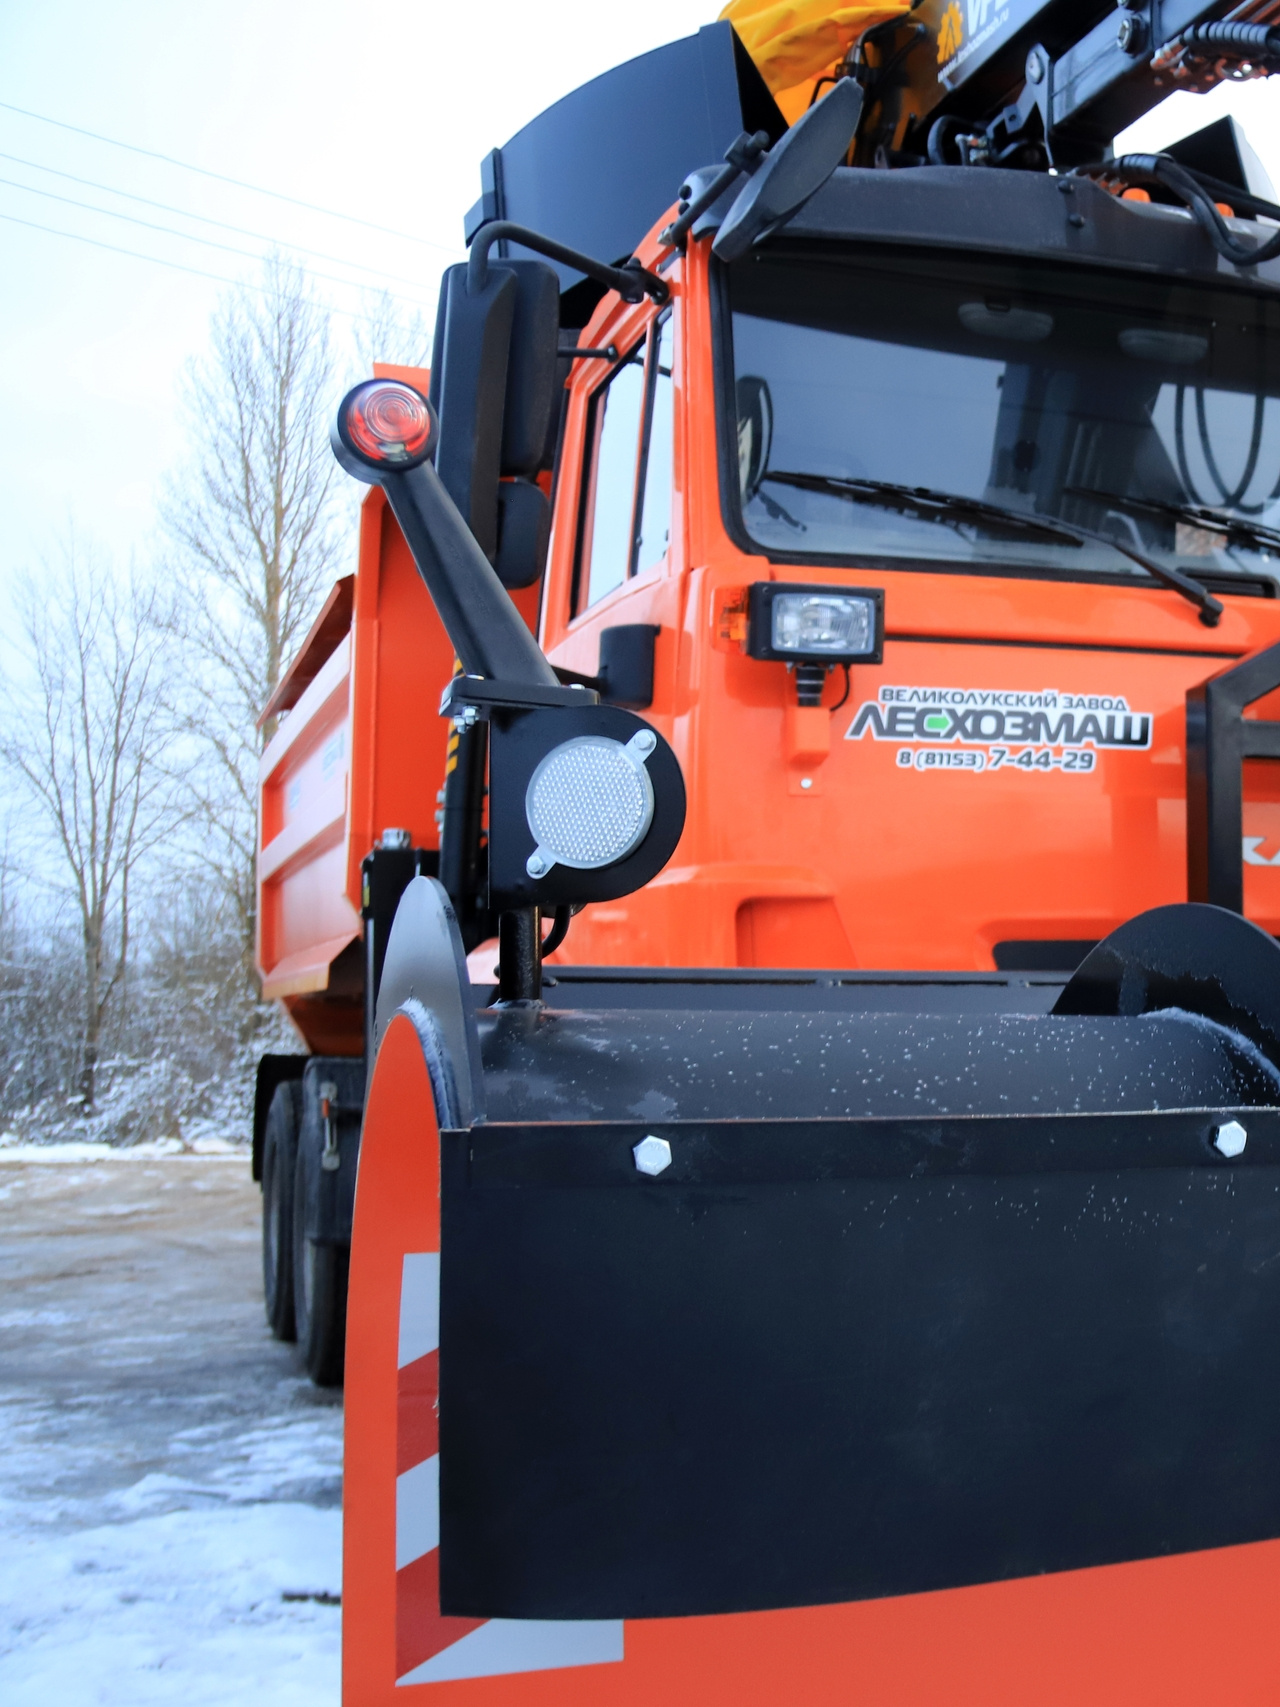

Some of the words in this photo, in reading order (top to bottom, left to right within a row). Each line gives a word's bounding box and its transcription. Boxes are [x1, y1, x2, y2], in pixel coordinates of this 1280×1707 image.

[881, 688, 1057, 708] ВЕЛИКОЛУКСКИЙ
[1063, 696, 1127, 712] ЗАВОД
[849, 704, 1150, 745] ЛЕСХОЗМАШ
[899, 751, 911, 766] 8
[917, 752, 985, 770] (81153)
[989, 750, 1094, 770] 7-44-29
